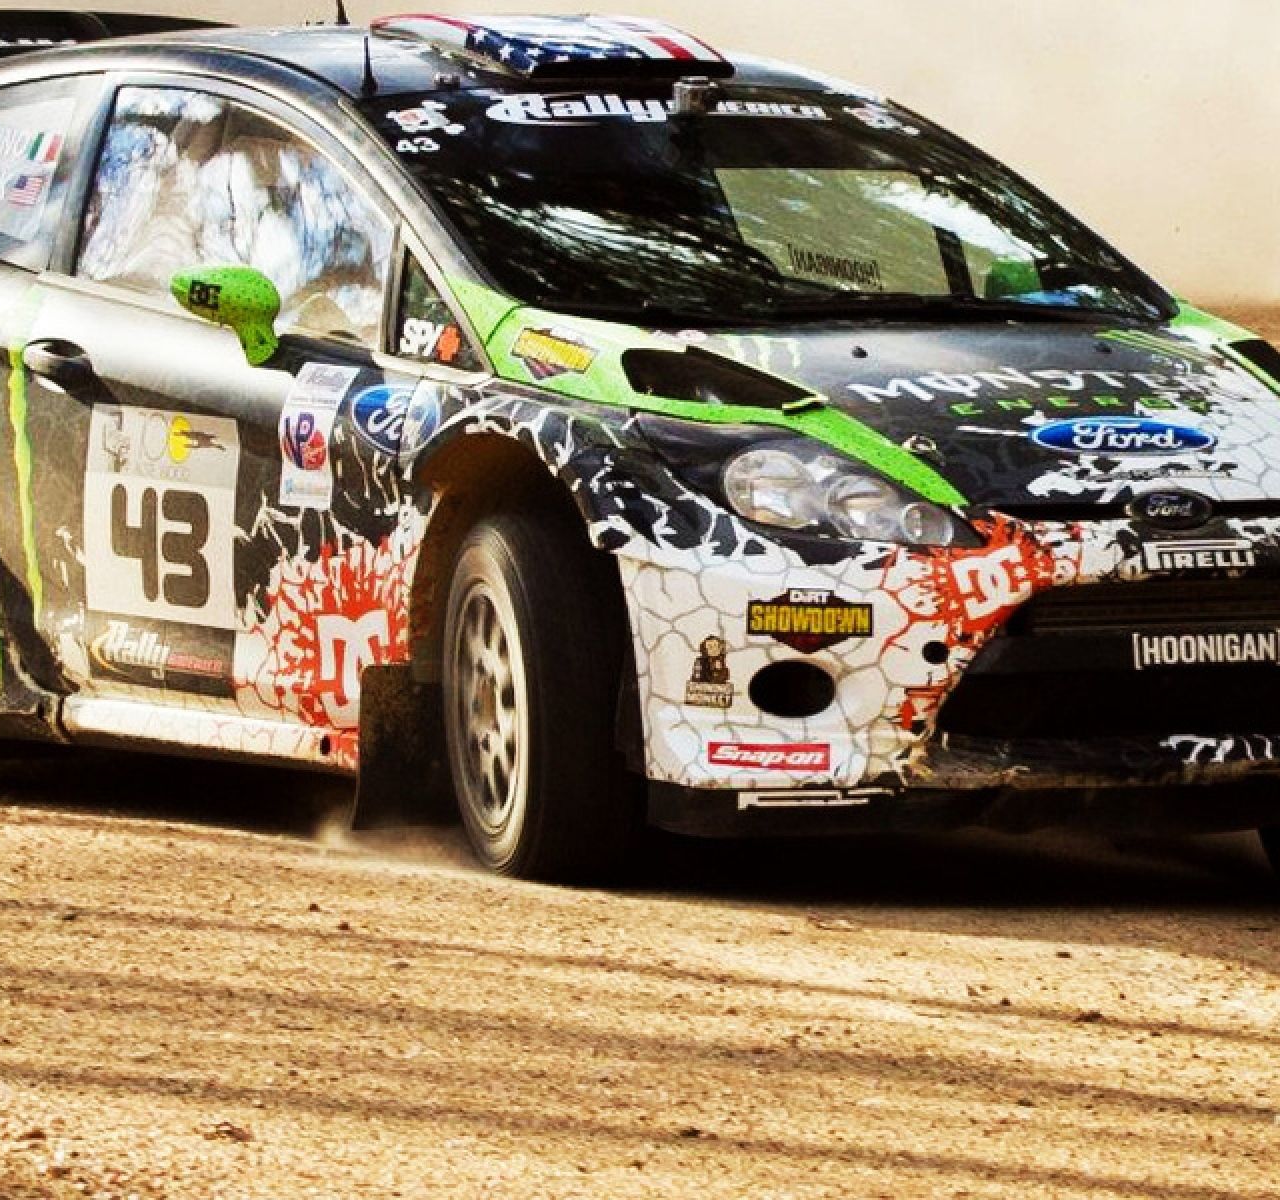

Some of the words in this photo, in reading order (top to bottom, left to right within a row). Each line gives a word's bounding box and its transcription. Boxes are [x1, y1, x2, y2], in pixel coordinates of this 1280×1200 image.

[486, 93, 667, 123] Rally
[716, 101, 827, 119] ERICA
[1070, 421, 1184, 450] Ford
[111, 483, 210, 608] 43
[1143, 540, 1256, 571] PIRELLI
[951, 545, 1032, 620] DC
[751, 604, 870, 633] SHOWDOWN
[712, 745, 825, 767] Snap-on
